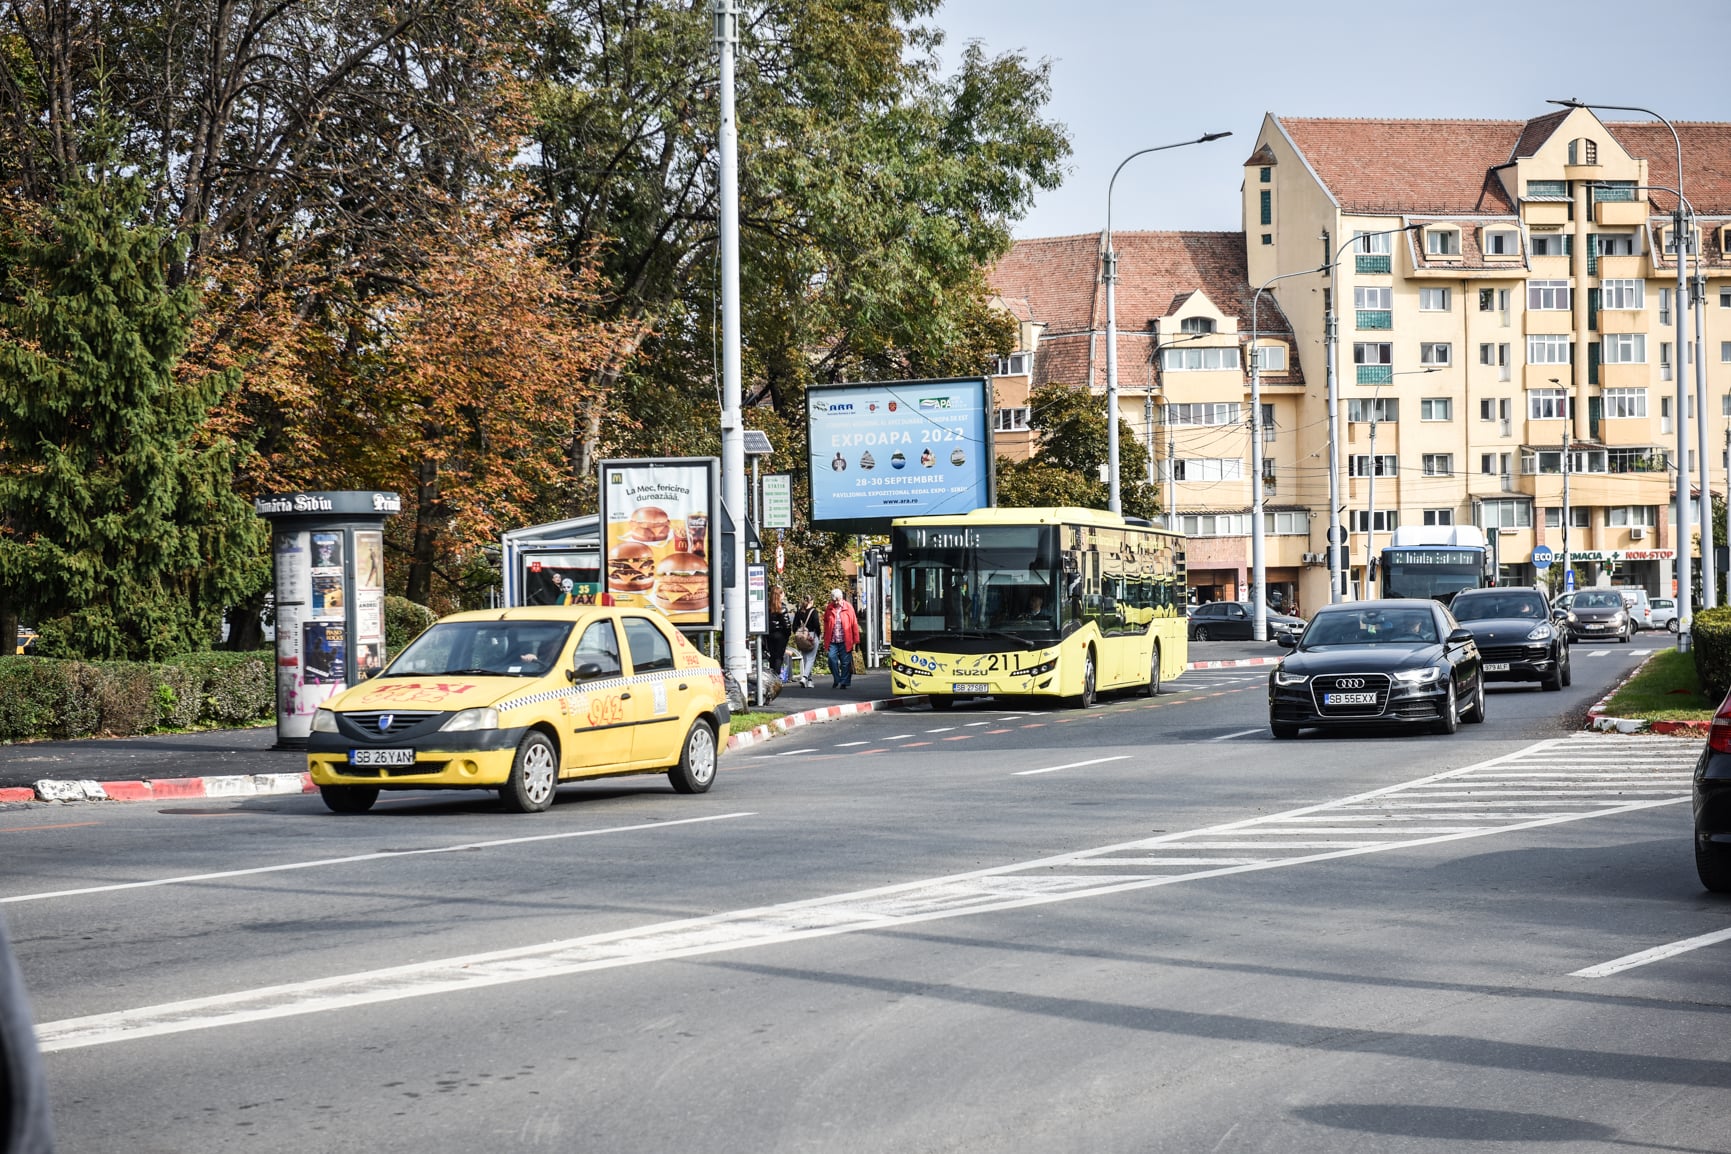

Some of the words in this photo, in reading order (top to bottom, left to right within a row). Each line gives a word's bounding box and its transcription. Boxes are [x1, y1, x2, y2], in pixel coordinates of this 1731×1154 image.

[829, 403, 854, 411] ARA
[934, 399, 952, 408] APA
[831, 430, 912, 447] EXPOAPA
[921, 427, 965, 443] 2022
[855, 478, 883, 487] 28-30
[884, 474, 944, 485] SEPTEMBRIE
[626, 488, 636, 496] La
[637, 485, 656, 493] Mec,
[657, 483, 690, 495] fericirea
[294, 494, 332, 511] Sibiu
[1534, 552, 1552, 561] ECO
[1554, 552, 1603, 561] FAMACIA
[1625, 551, 1674, 560] NON-STOP
[988, 654, 1019, 671] 211
[1329, 695, 1341, 704] SB
[356, 751, 371, 763] SB
